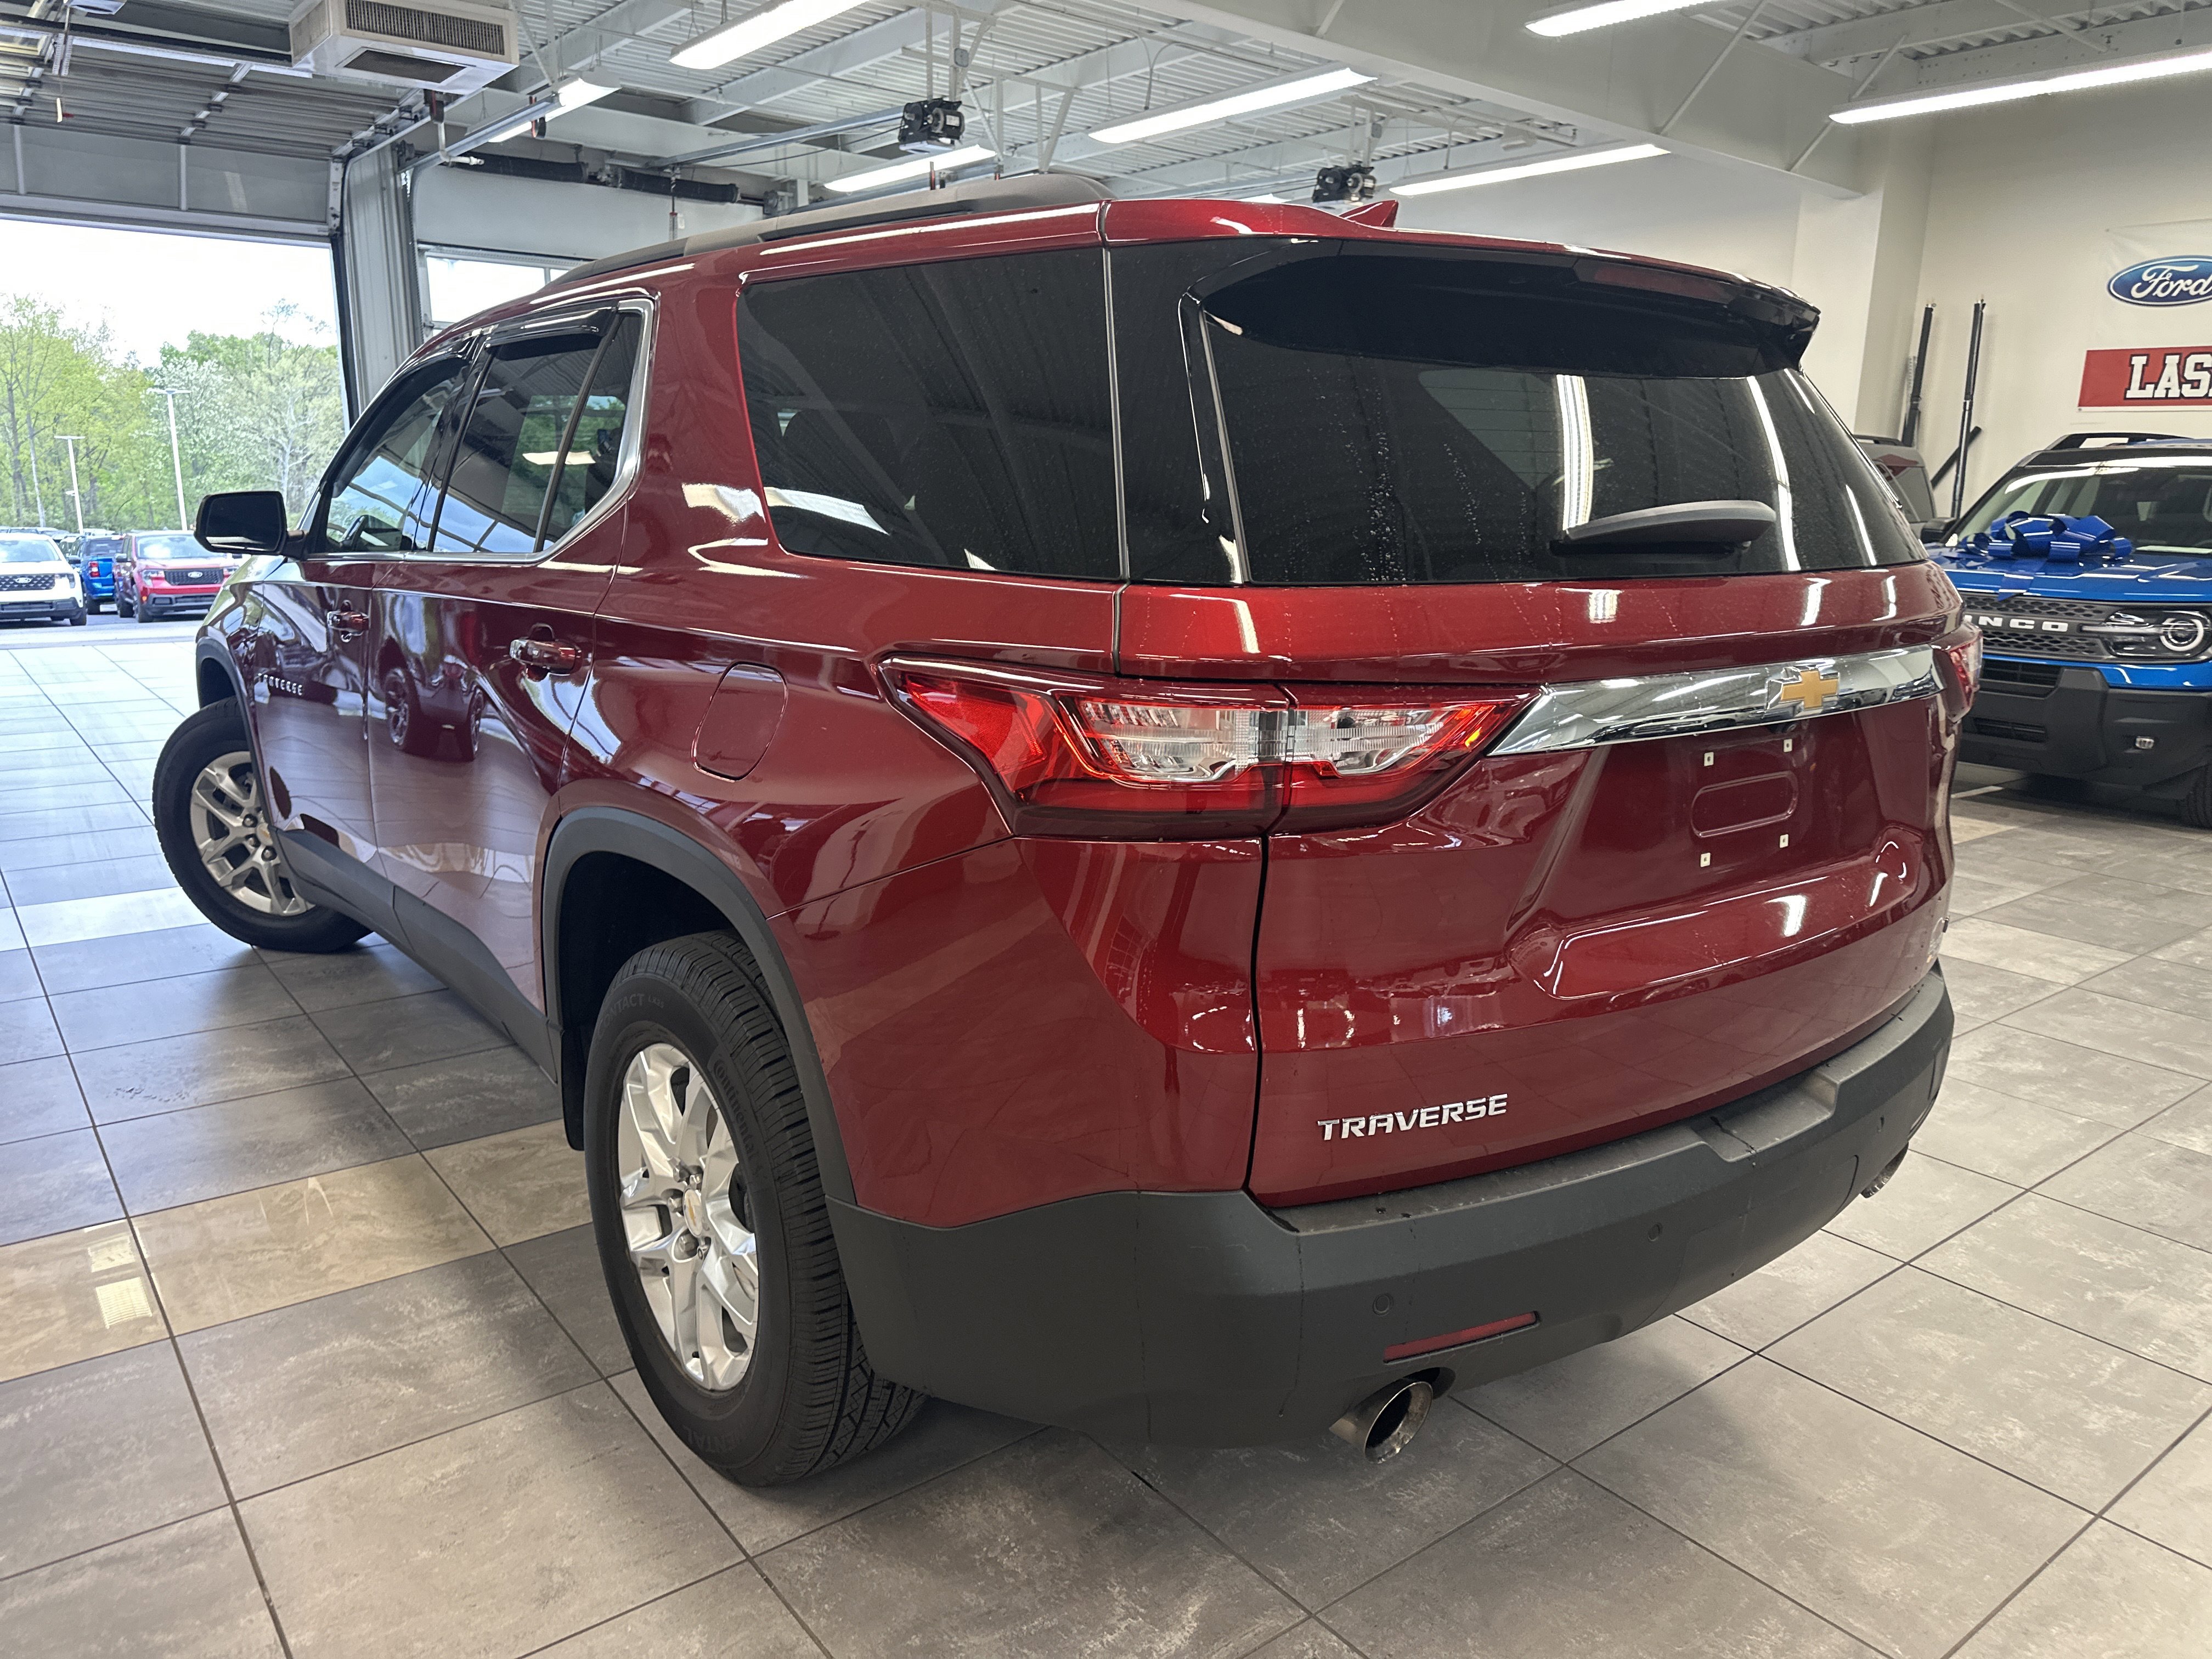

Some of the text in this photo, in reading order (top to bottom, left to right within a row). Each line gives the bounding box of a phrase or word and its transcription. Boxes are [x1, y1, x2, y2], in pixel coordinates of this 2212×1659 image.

[2131, 264, 2212, 298] Ford
[2125, 352, 2212, 399] LAS
[1317, 1093, 1508, 1141] TRAVERSE
